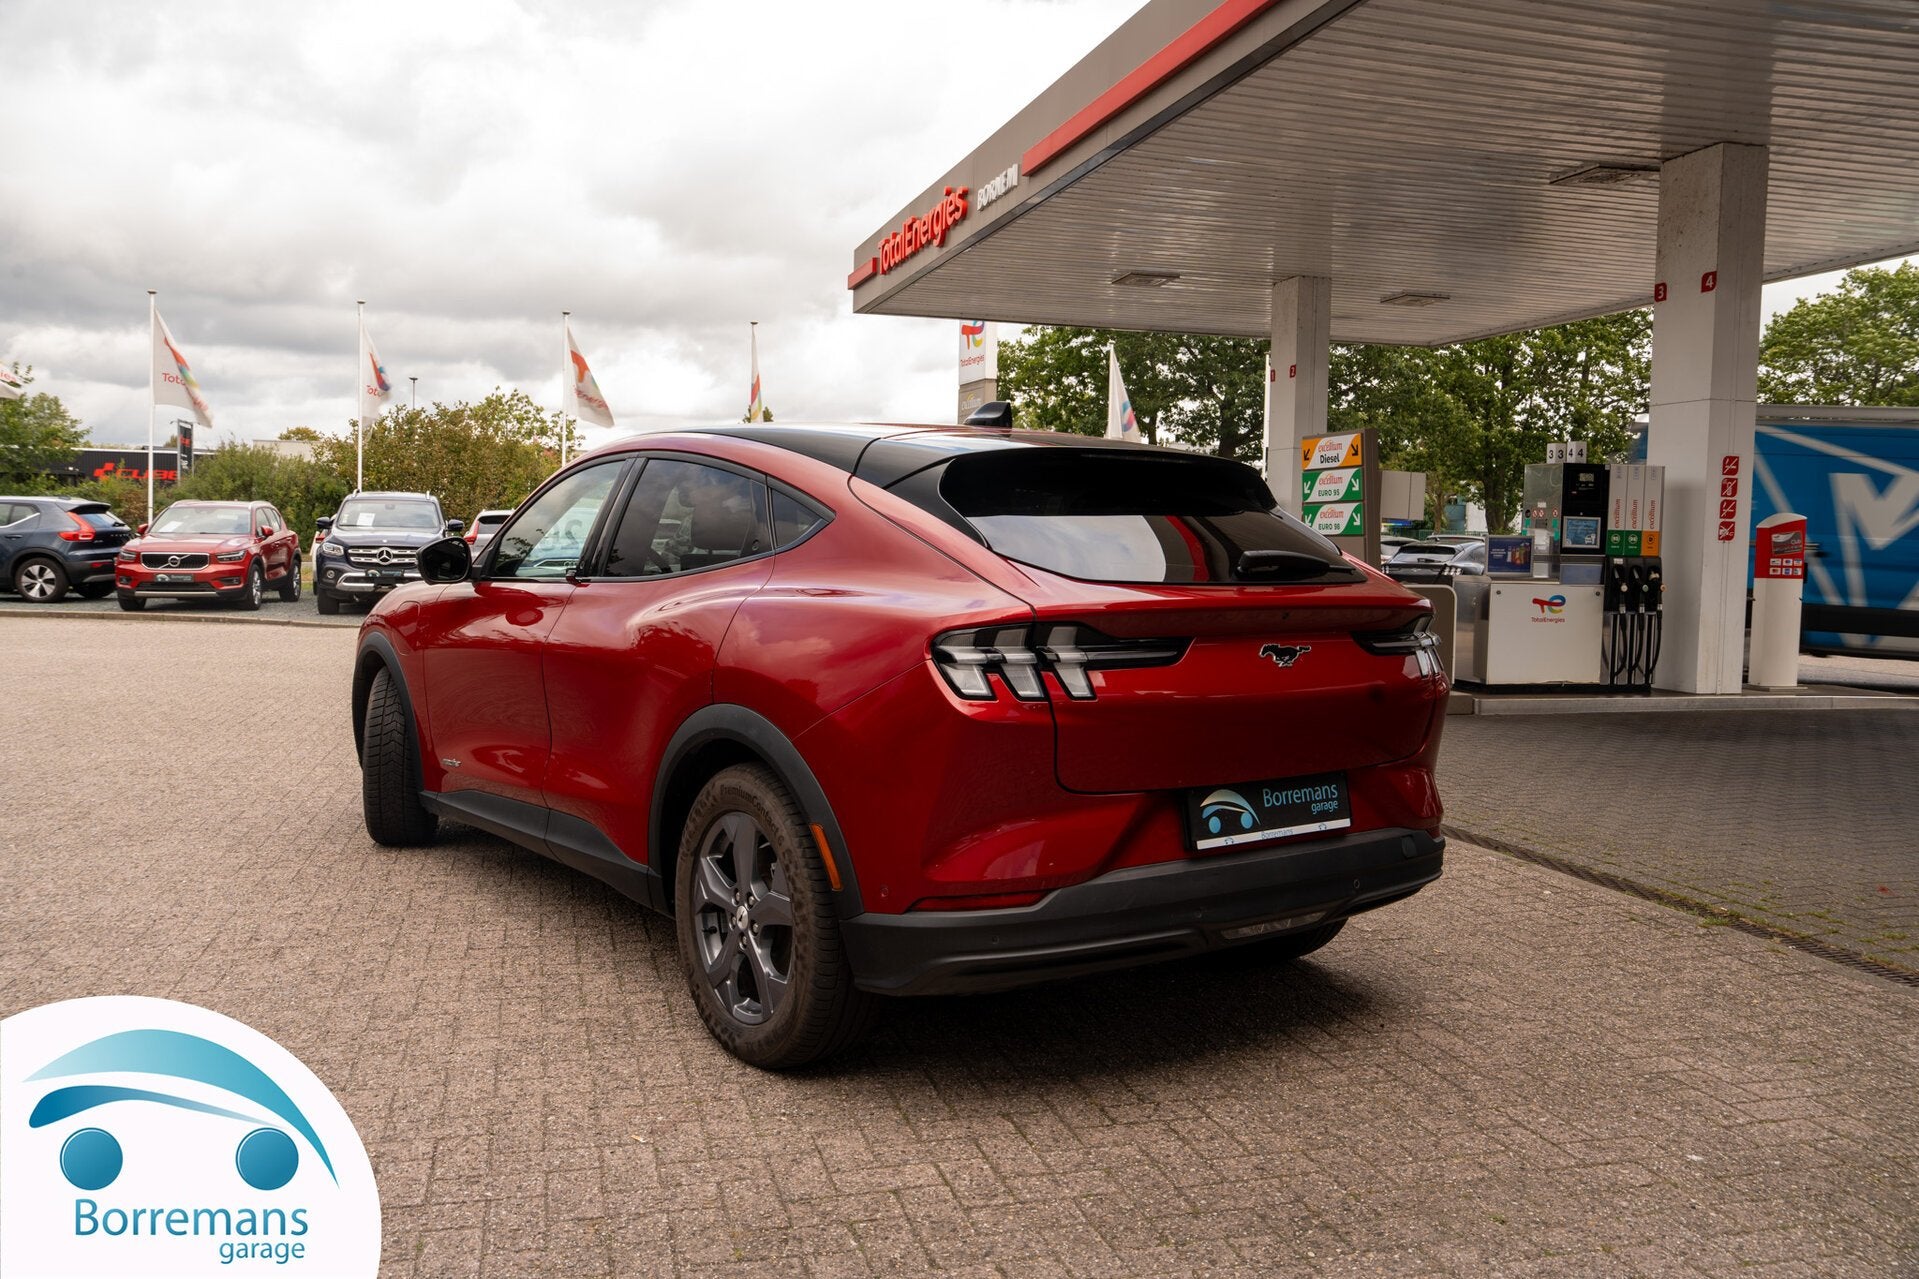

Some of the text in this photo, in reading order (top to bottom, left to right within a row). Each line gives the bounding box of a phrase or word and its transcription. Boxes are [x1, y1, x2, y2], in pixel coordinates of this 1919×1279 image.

[977, 163, 1018, 211] BORNEM
[878, 186, 969, 275] TotalEnergies
[1705, 275, 1714, 288] 4
[1320, 454, 1340, 464] Diesel
[1318, 489, 1332, 497] EURO
[1318, 523, 1332, 531] EURO
[1531, 616, 1565, 624] TotalEnergies
[1262, 784, 1339, 808] Borremans
[1311, 800, 1339, 815] garage
[1261, 828, 1294, 840] Borremans
